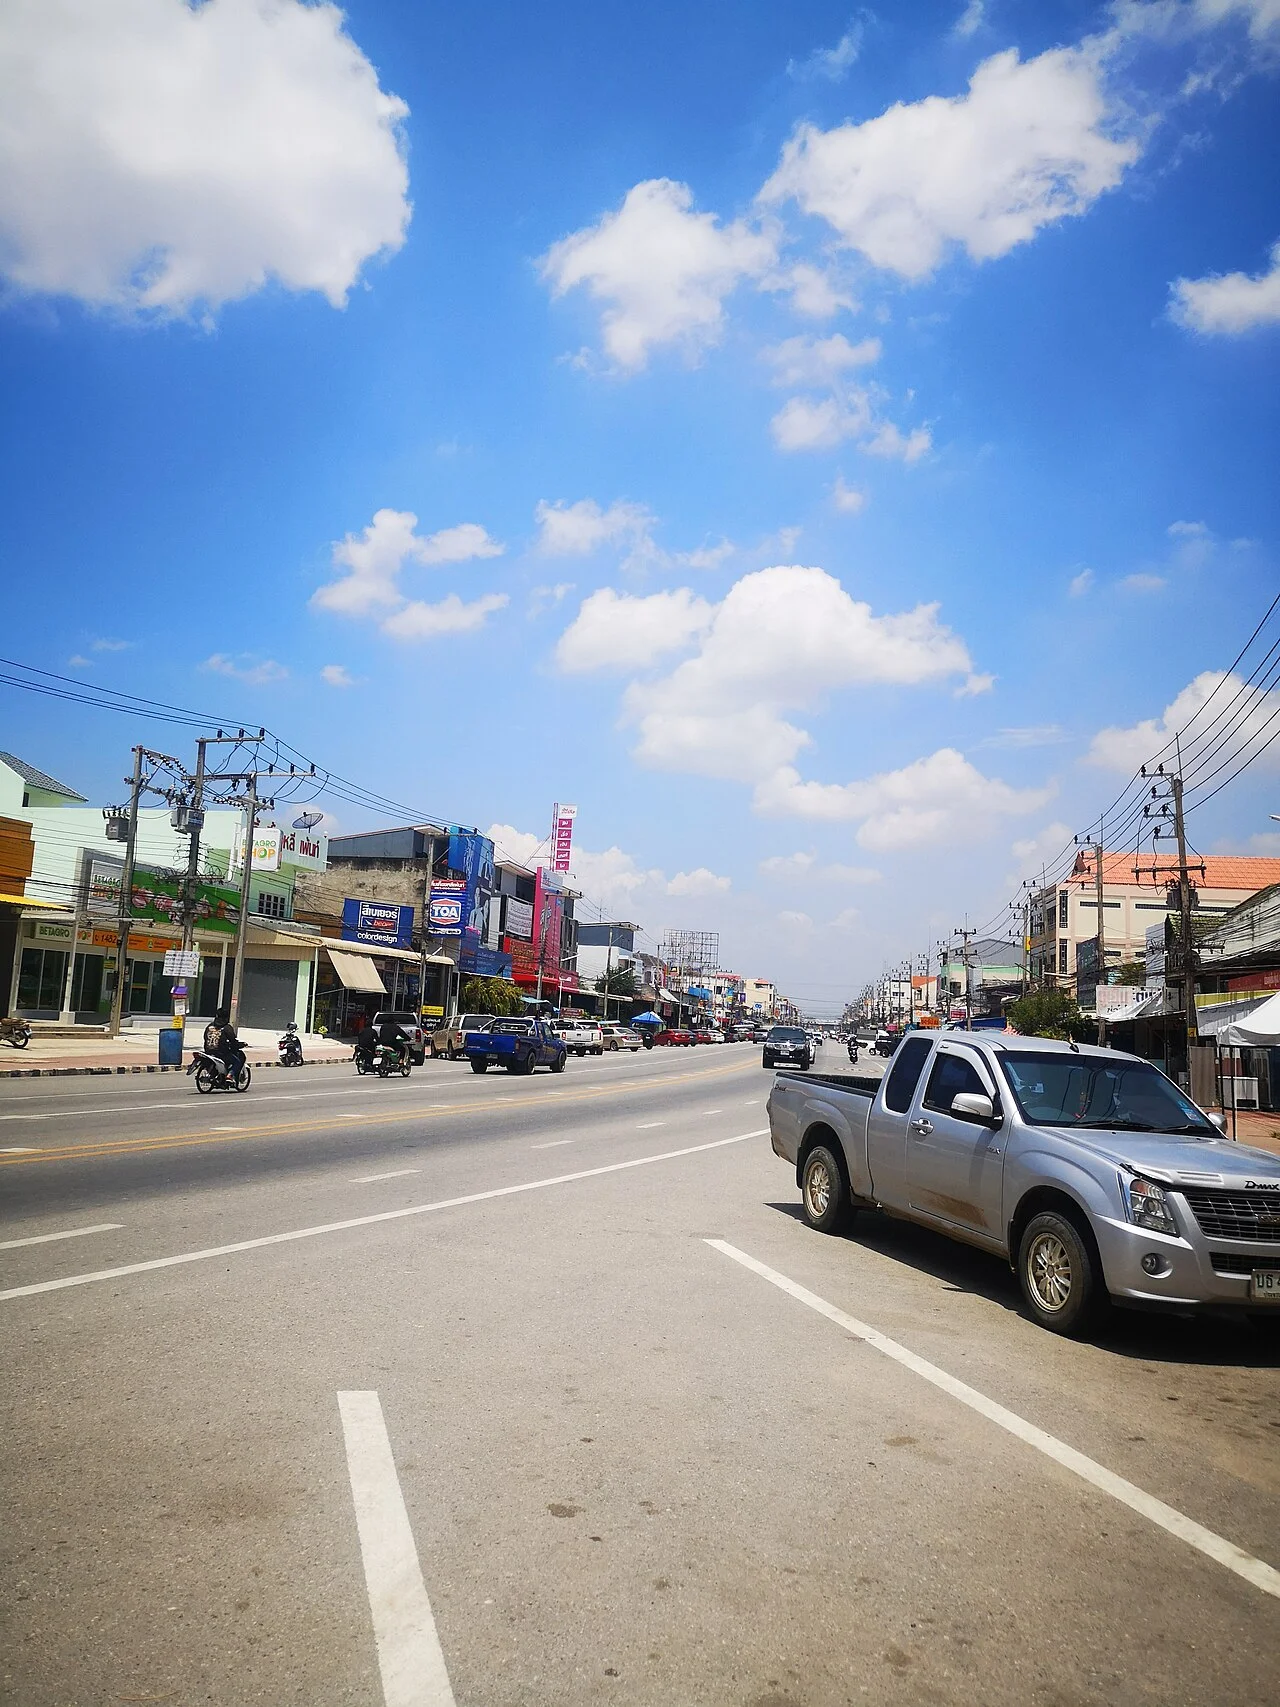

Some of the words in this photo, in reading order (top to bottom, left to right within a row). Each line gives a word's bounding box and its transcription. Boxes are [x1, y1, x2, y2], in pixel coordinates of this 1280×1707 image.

[433, 906, 458, 918] TOA
[39, 925, 70, 938] BETAGRO
[101, 934, 117, 944] 1482
[357, 932, 398, 944] colordesign
